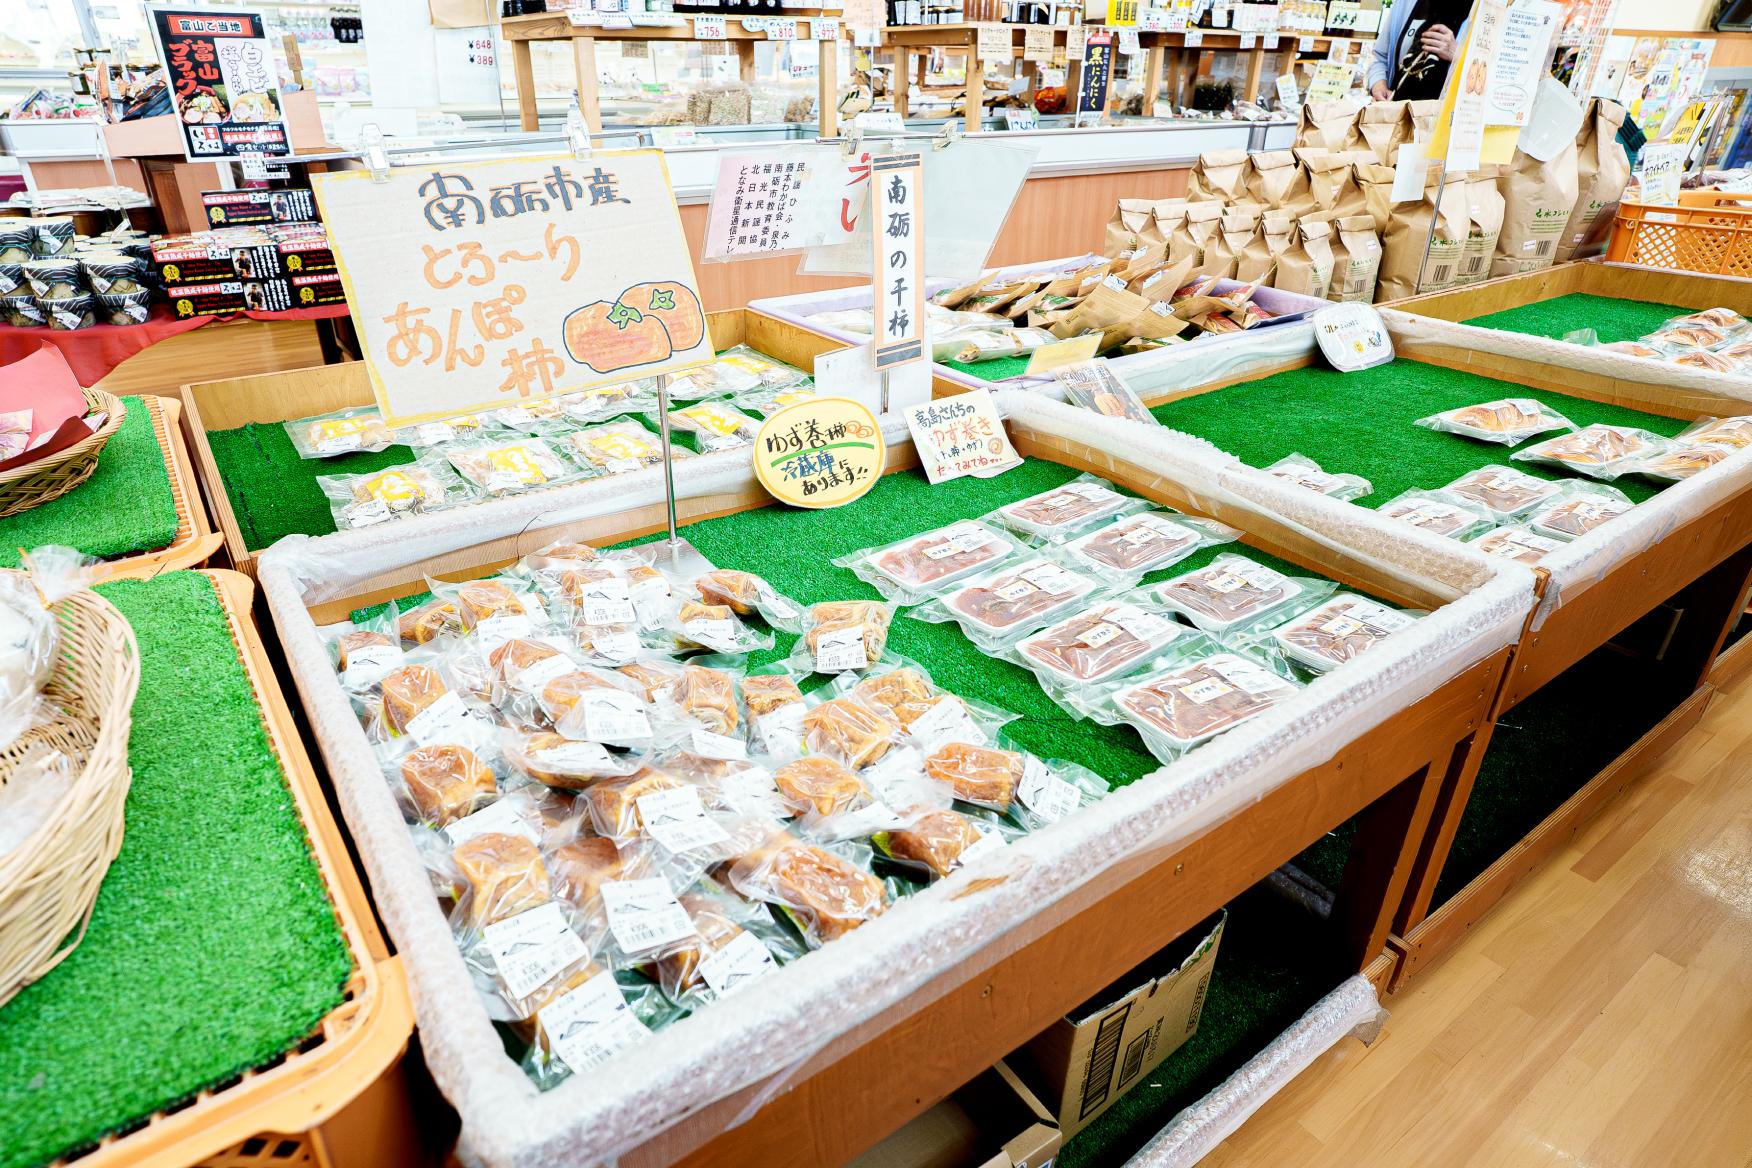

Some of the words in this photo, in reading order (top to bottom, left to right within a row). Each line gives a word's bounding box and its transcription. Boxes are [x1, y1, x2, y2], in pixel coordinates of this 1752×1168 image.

[180, 20, 242, 32] 富山ご当地
[704, 26, 720, 37] 756
[778, 27, 793, 38] 810
[168, 38, 197, 96] ブラック
[191, 39, 219, 80] 富山
[1087, 46, 1104, 109] 黒にんにく
[418, 165, 631, 232] 南砺市産
[750, 164, 772, 252] 福光民謡協
[759, 163, 783, 251] 南砺市教育委員
[782, 162, 805, 250] 民謡ひふみ
[886, 174, 911, 339] 南砺の干柿
[499, 336, 566, 397] 柿
[914, 402, 976, 429] 高島さんちの
[780, 449, 849, 482] 冷蔵庫に
